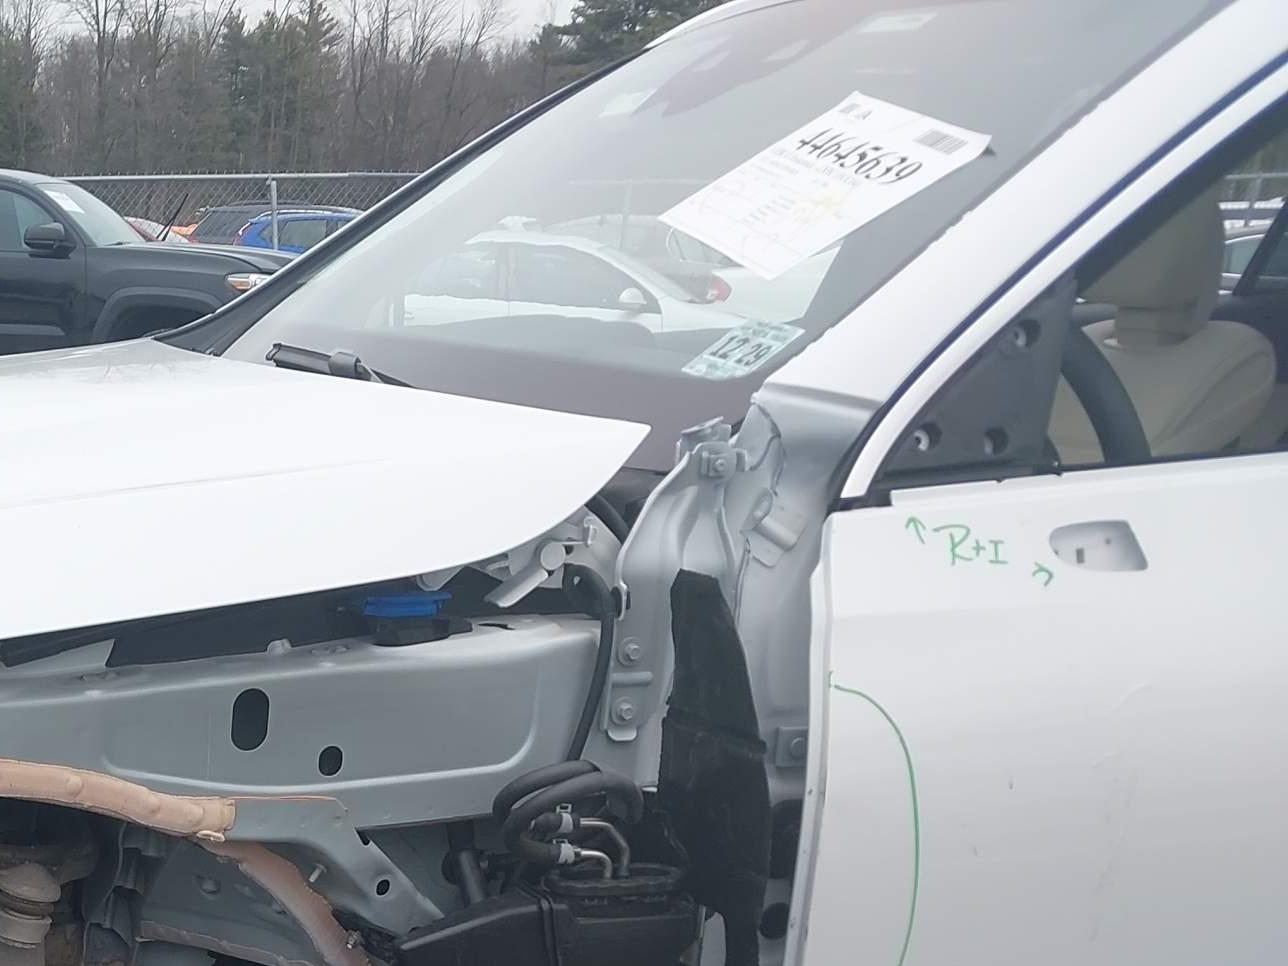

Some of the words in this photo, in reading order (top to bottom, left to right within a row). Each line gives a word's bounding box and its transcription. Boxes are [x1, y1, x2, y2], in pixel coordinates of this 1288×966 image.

[796, 128, 923, 184] 44645639
[709, 335, 750, 360] 12
[734, 343, 773, 367] 29
